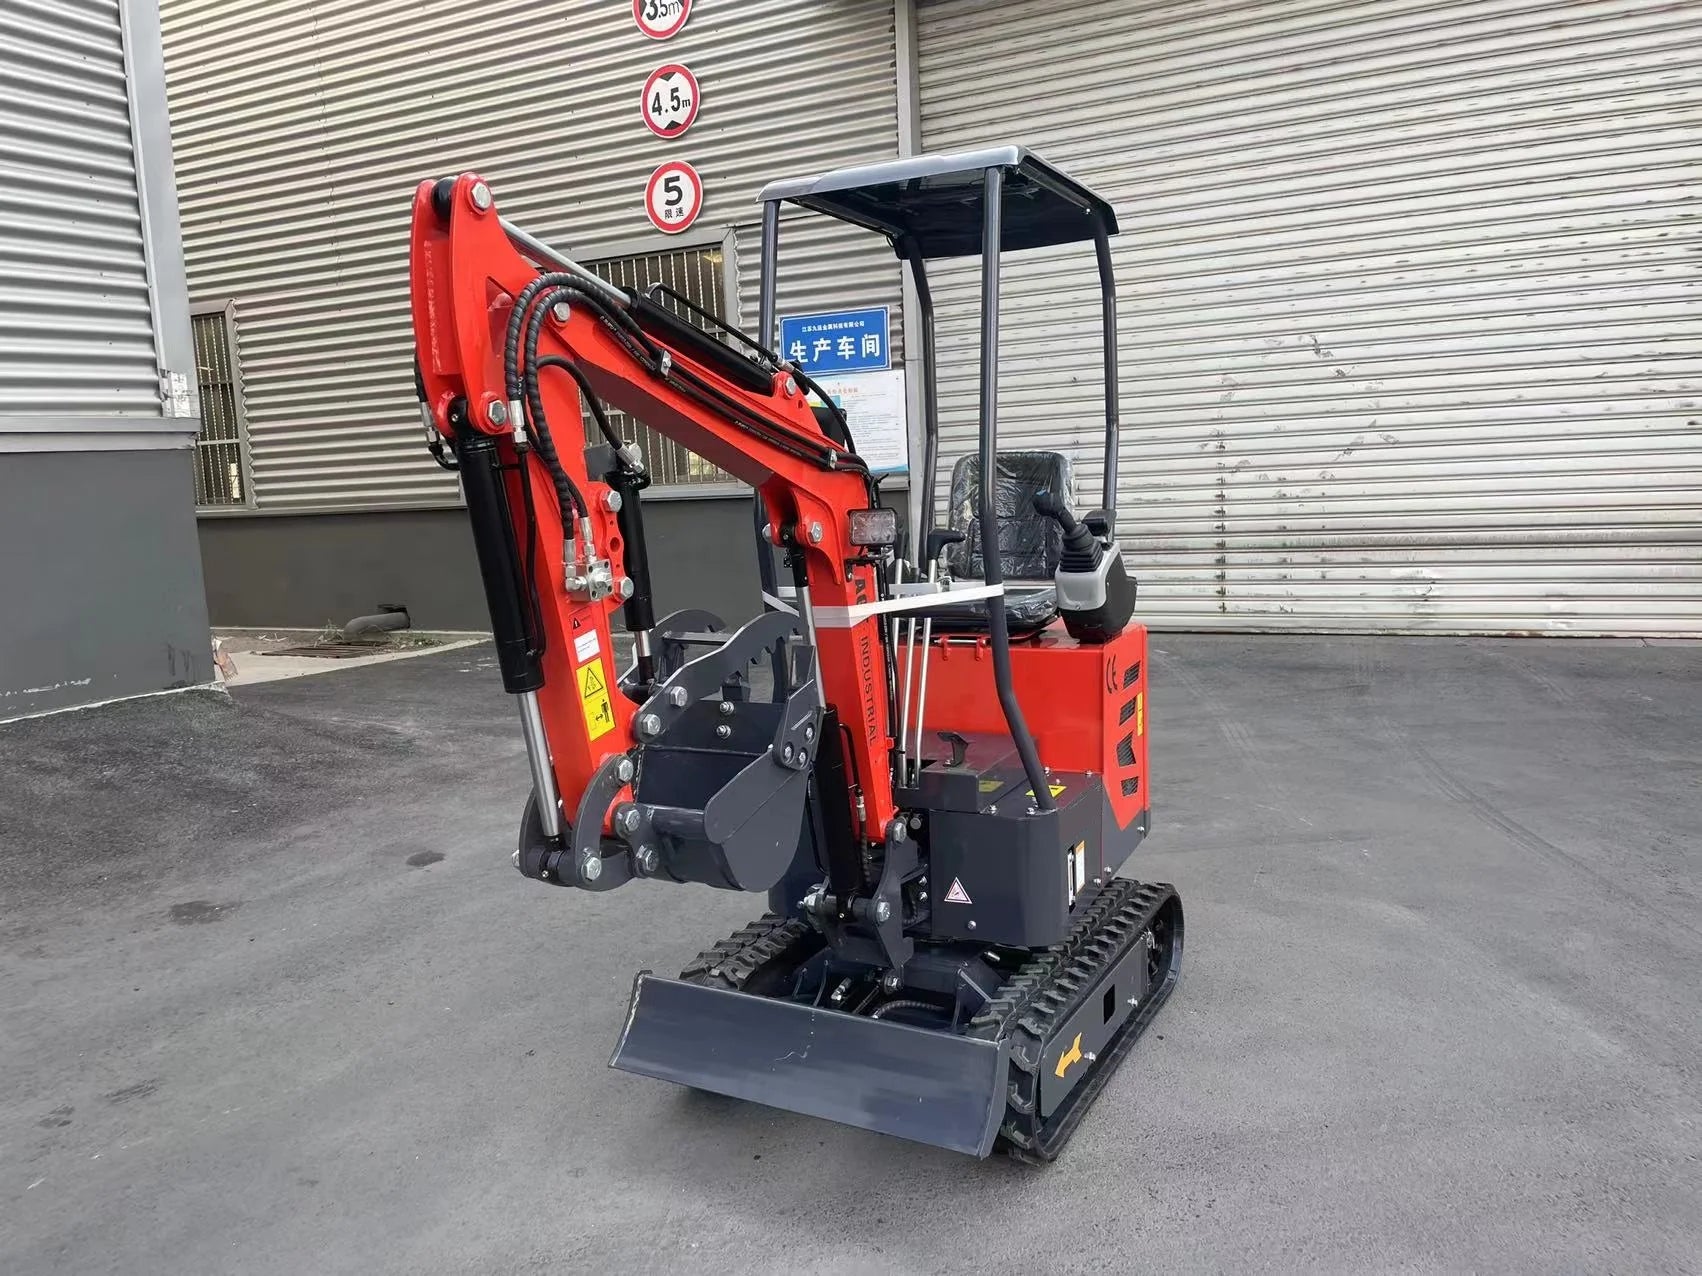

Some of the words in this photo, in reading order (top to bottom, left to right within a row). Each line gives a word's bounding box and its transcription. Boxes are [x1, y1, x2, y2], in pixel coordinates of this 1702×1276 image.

[651, 87, 691, 116] 4.5m
[664, 175, 683, 206] 5
[664, 207, 684, 219] 限速
[789, 333, 880, 363] 生产车间
[860, 635, 877, 747] INDUSTRIAL
